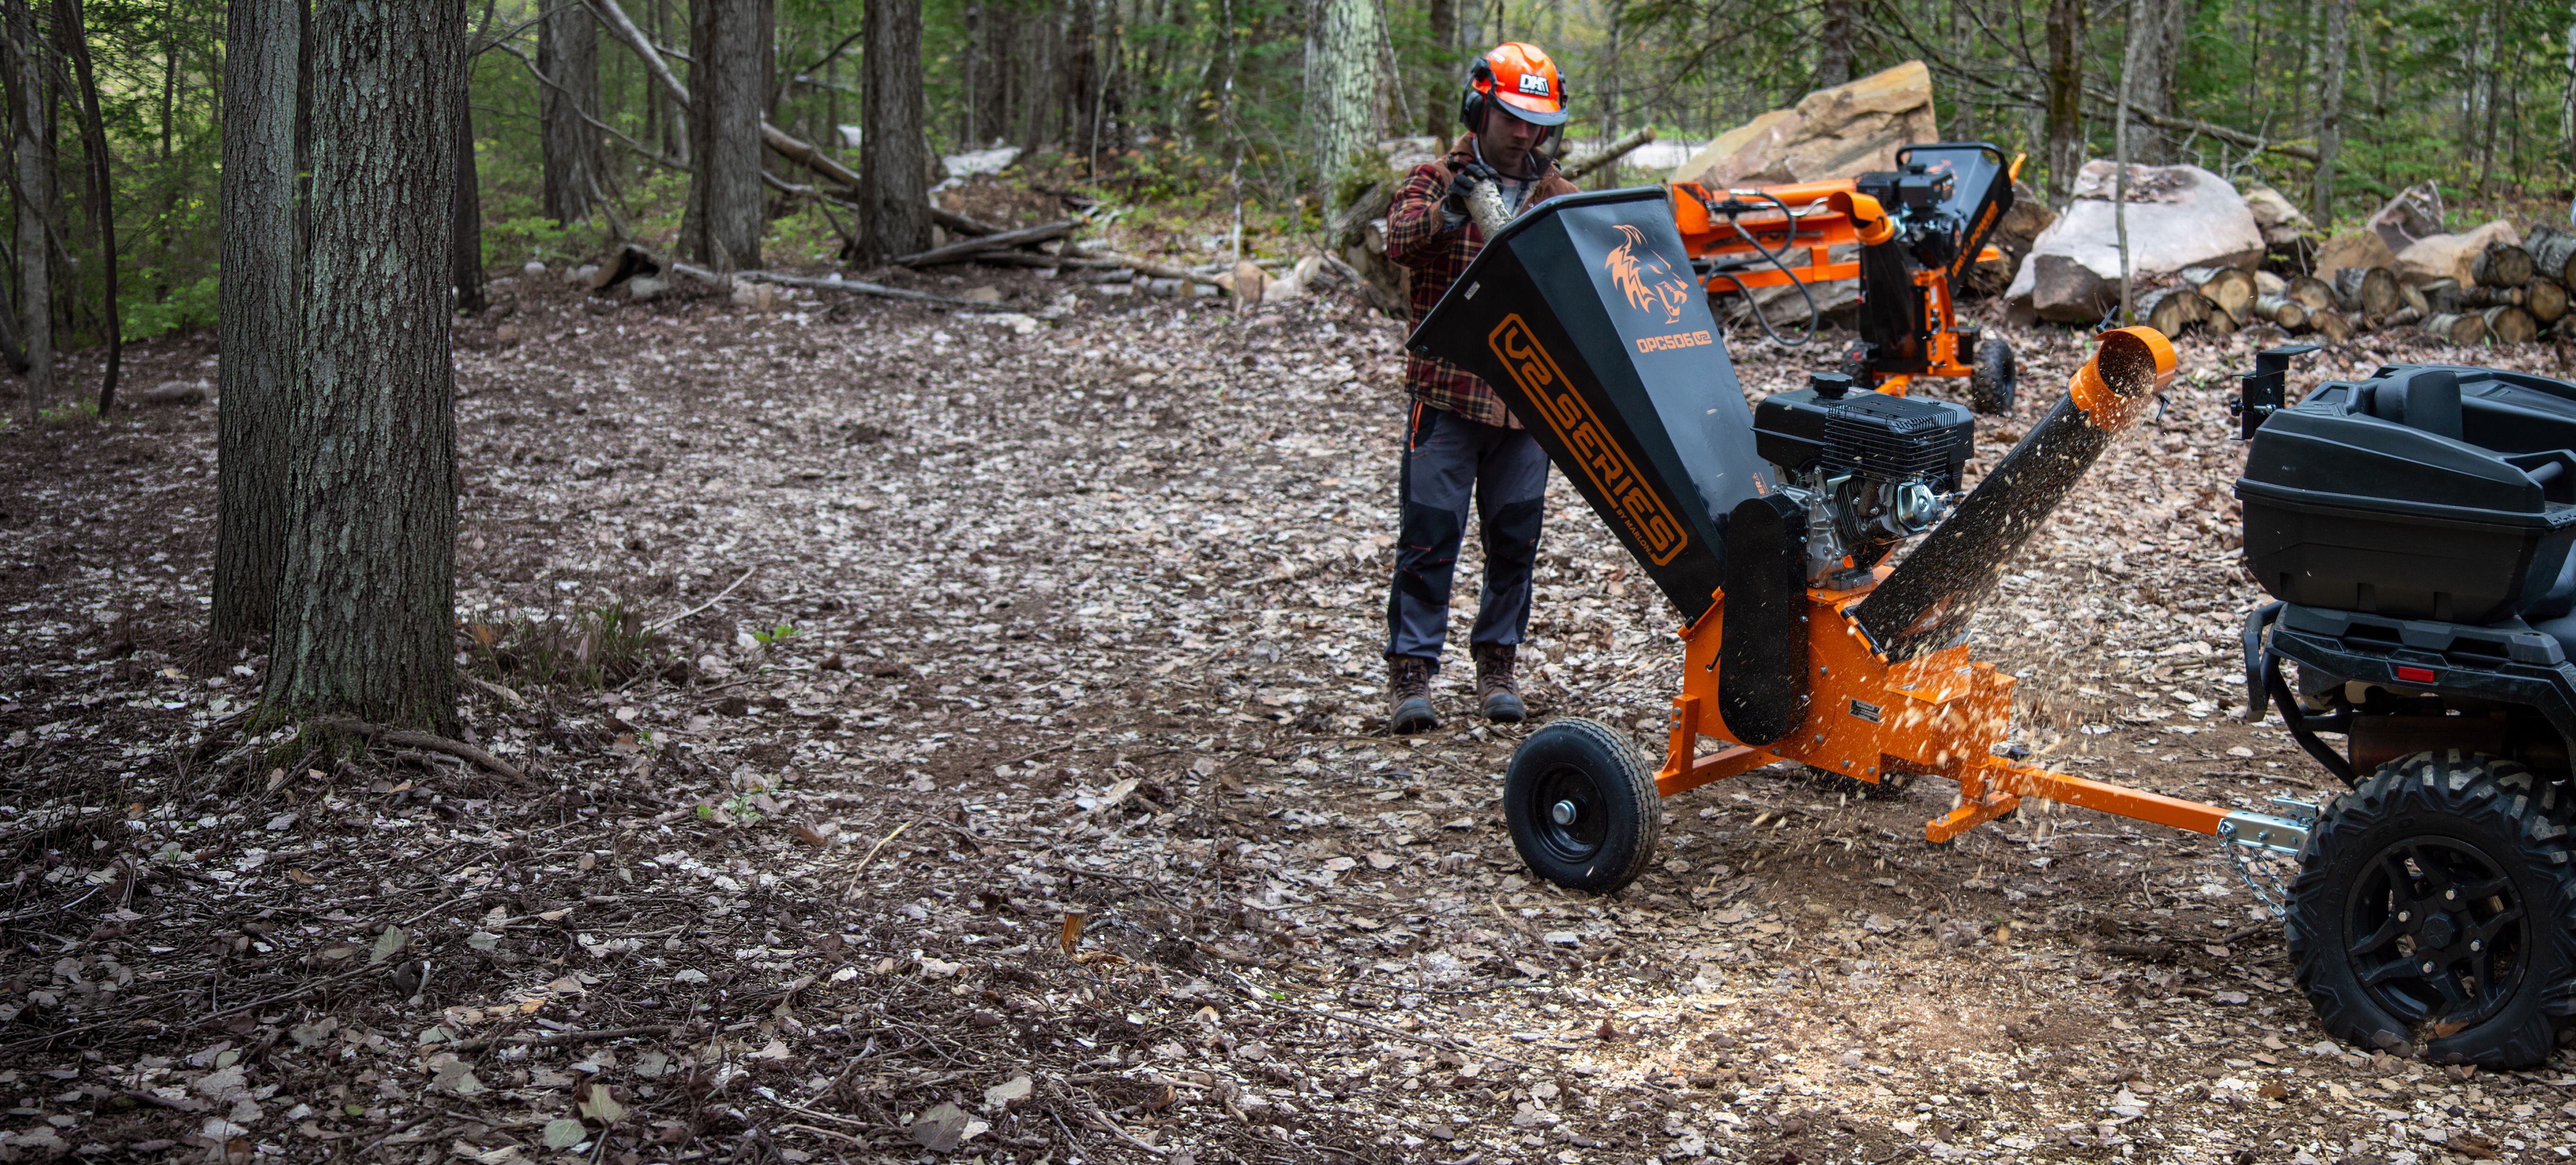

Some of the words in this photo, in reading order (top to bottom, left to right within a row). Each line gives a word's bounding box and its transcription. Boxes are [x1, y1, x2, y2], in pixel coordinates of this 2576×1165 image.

[1505, 326, 1552, 385] V2
[1557, 393, 1675, 553] SERIES
[1616, 508, 1627, 518] BY
